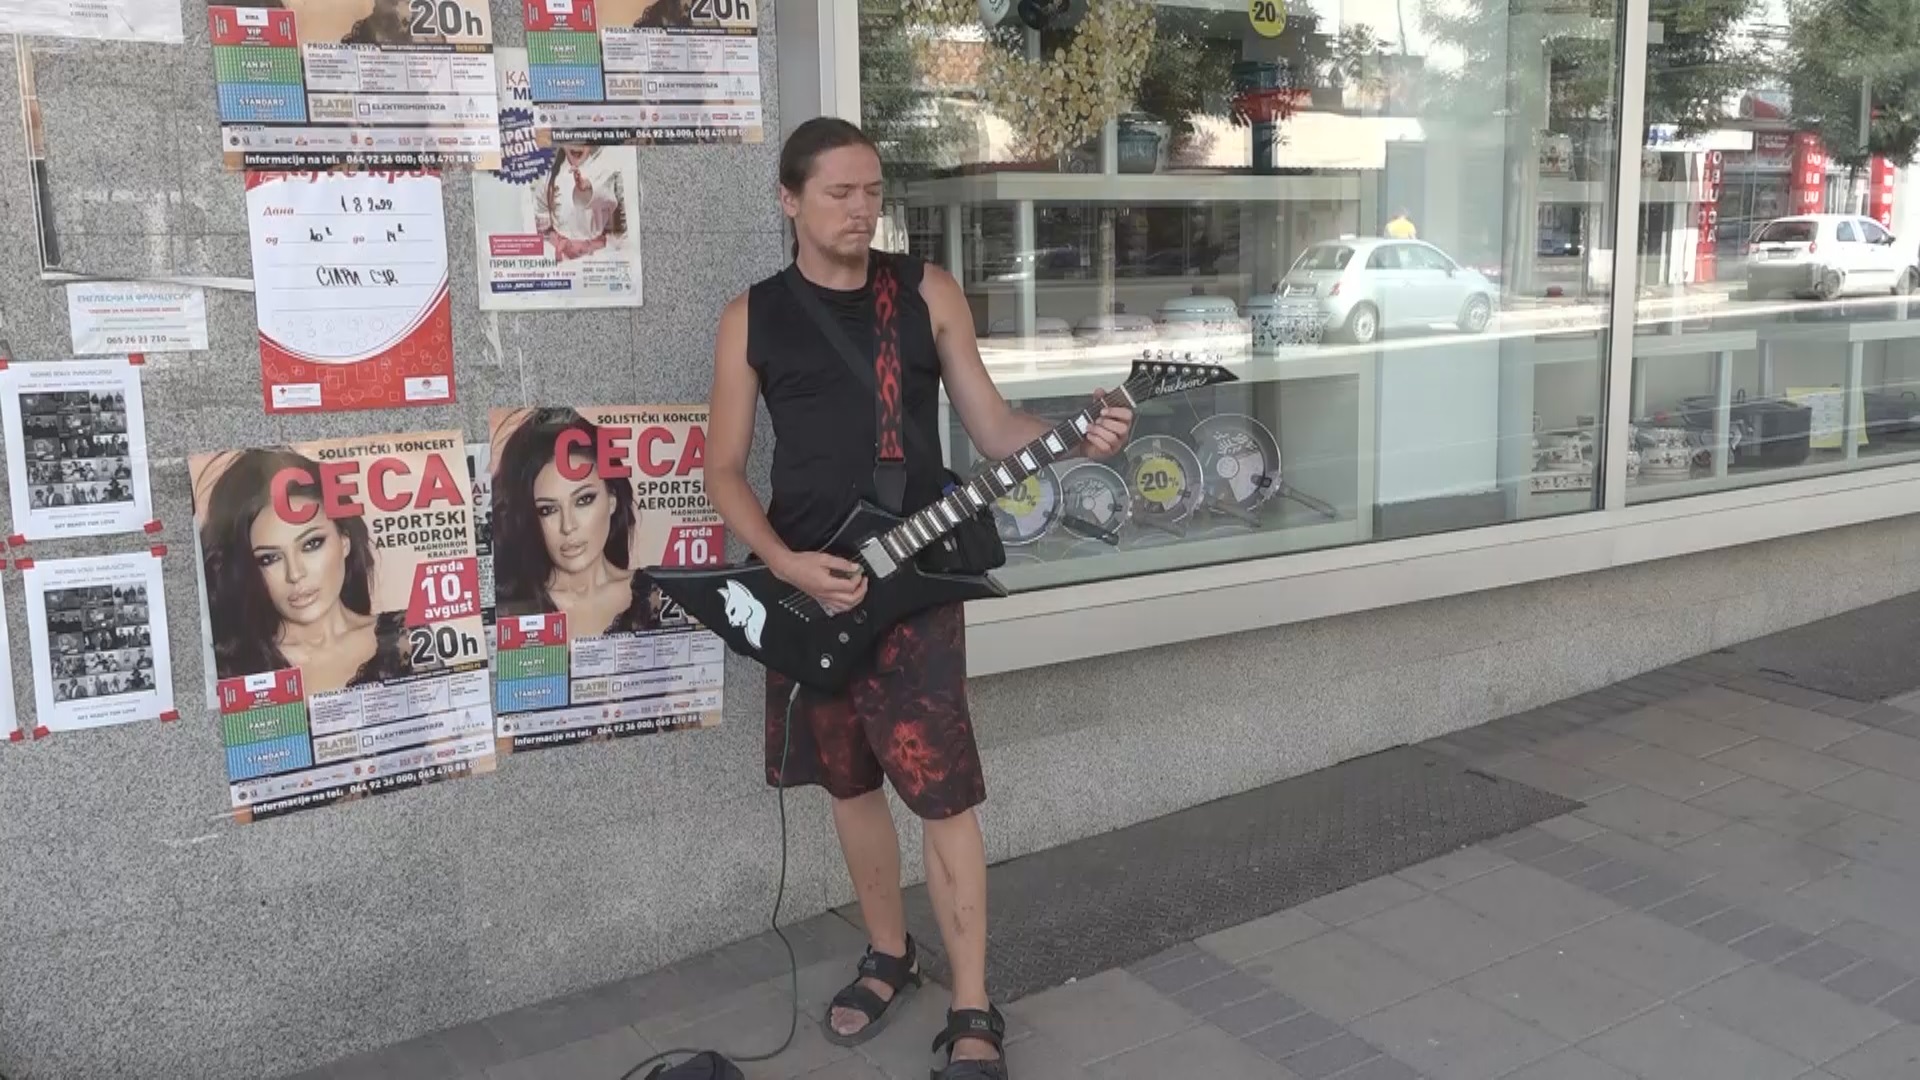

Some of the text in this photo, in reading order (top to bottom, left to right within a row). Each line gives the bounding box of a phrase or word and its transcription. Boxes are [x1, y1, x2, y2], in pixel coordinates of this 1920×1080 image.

[410, 0, 484, 37] 20h
[247, 27, 261, 36] VIP
[608, 79, 643, 88] ZLATNI
[552, 131, 602, 141] Informacije
[616, 130, 631, 138] tel:
[652, 130, 664, 138] 92
[711, 129, 726, 137] 470
[245, 155, 306, 166] Informacije
[322, 155, 340, 164] tel:
[346, 155, 364, 165] 064
[366, 155, 379, 165] 92
[381, 155, 393, 165] 36
[418, 155, 435, 165] 065
[437, 155, 454, 164] 470
[456, 155, 470, 163] 88
[471, 155, 483, 163] 00
[489, 259, 516, 269] ПРВИ
[1155, 376, 1207, 394] Jackson
[597, 411, 660, 424] SOLISTIČKI
[318, 439, 455, 460] SOLISTIČKI KONCERT
[554, 425, 706, 481] CECA
[269, 453, 466, 525] CECA
[637, 480, 706, 496] SPORTS
[372, 511, 466, 534] SPORTSKI
[375, 527, 467, 550] AERODROM
[679, 527, 713, 538] sreda
[413, 541, 468, 553] MAGNOHROM
[427, 548, 469, 559] KRALJEVO
[673, 538, 718, 566] 10.
[425, 560, 465, 575] sreda
[420, 574, 473, 606] 10.
[424, 601, 473, 619] avgust
[410, 626, 479, 665] 20h
[514, 688, 552, 698] STANDARD
[317, 735, 357, 751] ZLATNI
[514, 733, 564, 746] Informacije
[247, 750, 291, 764] STANDARD
[253, 796, 311, 815] Informacije
[312, 793, 325, 802] na
[326, 788, 344, 799] tel:
[350, 784, 368, 794] 064
[369, 780, 381, 790] 92
[383, 778, 395, 788] 36
[418, 769, 436, 779] 065
[436, 765, 454, 775] 470
